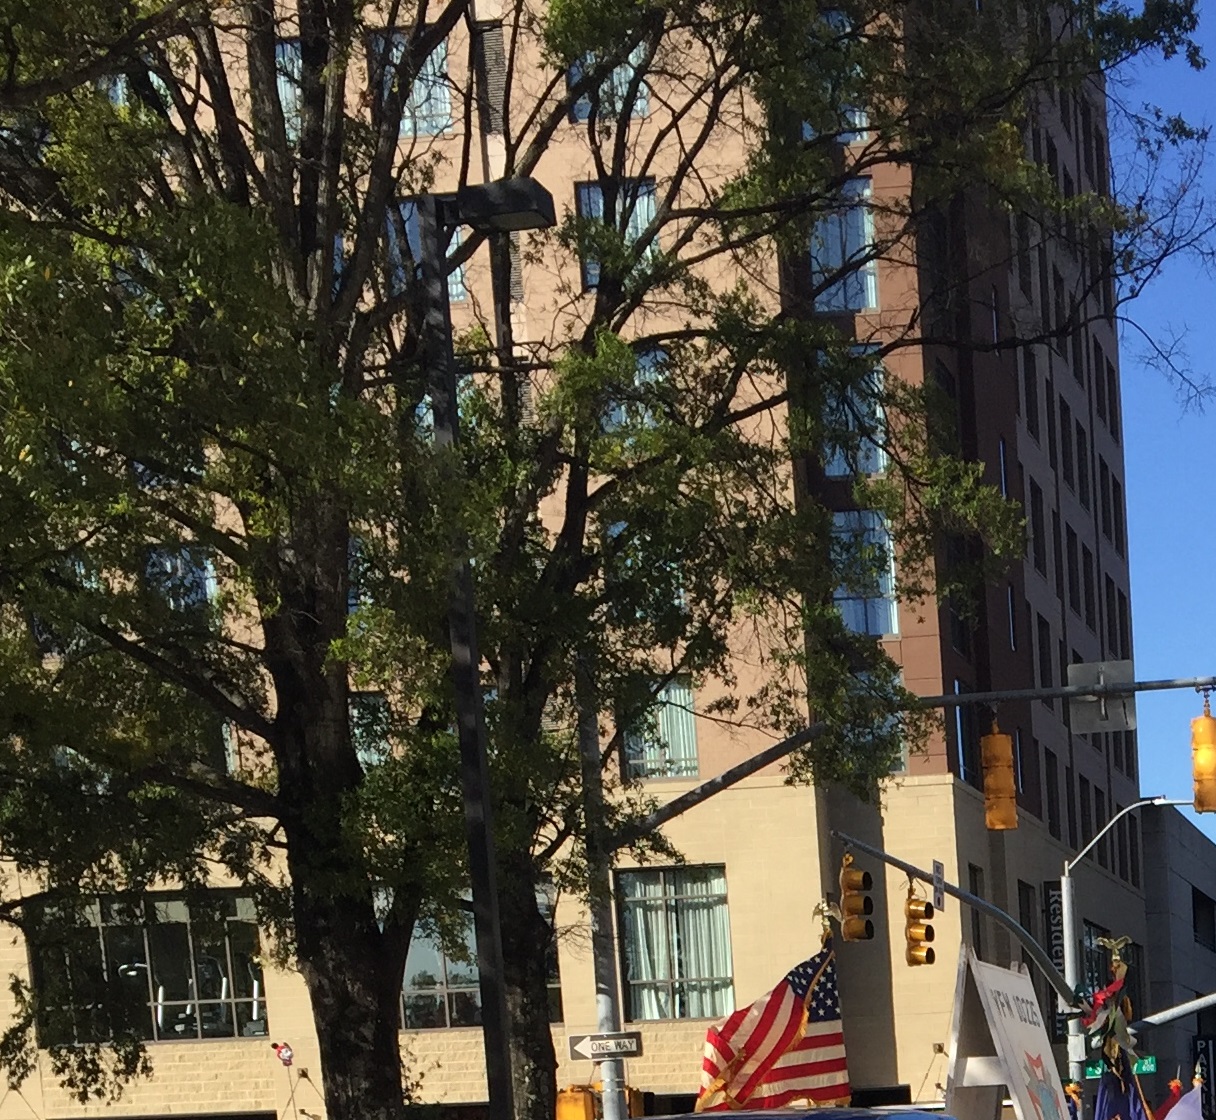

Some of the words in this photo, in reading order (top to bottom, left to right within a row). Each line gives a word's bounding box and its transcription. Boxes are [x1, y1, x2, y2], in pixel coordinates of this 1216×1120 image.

[1050, 889, 1065, 979] Residen
[591, 1042, 612, 1052] ONE
[614, 1040, 635, 1051] WAY
